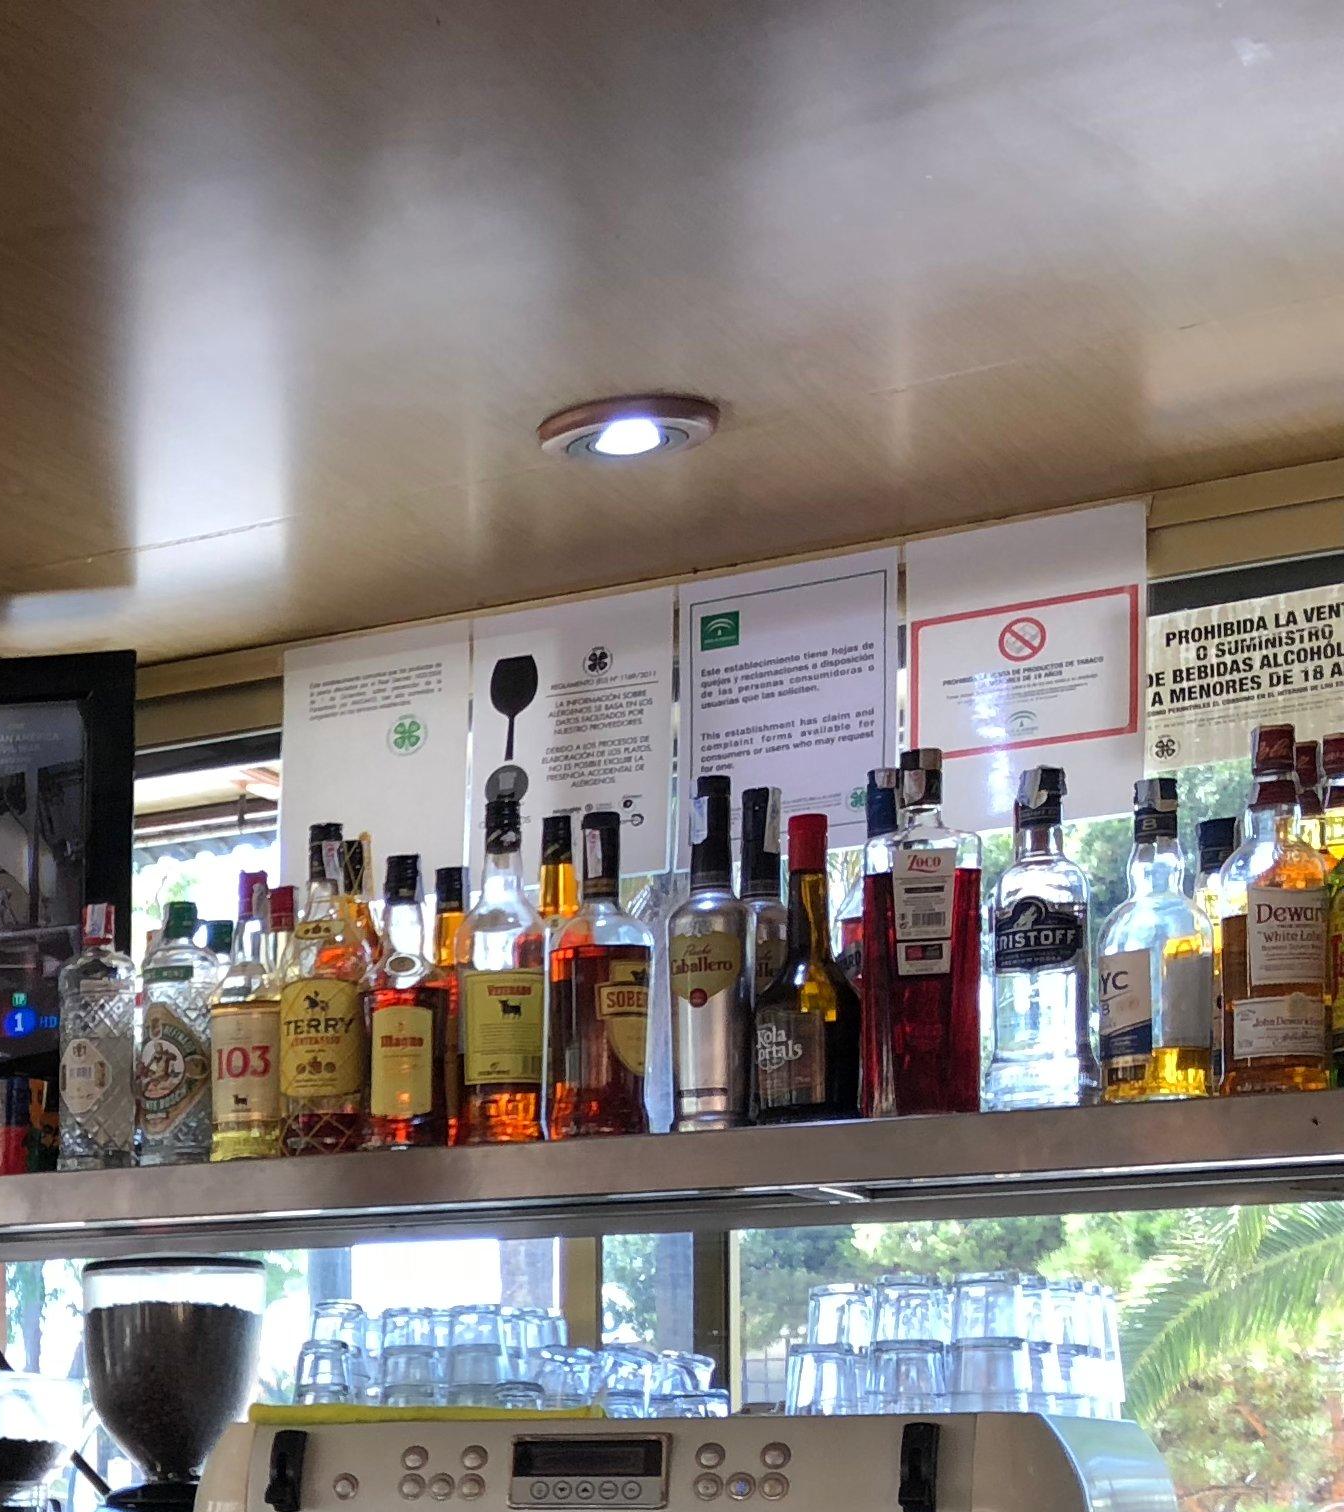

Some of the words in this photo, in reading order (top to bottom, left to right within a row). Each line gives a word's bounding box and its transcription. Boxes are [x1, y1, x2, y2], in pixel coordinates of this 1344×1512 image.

[1165, 616, 1268, 647] PROHIBIDA
[1274, 610, 1298, 628] LA
[1303, 602, 1344, 622] VEN
[1196, 645, 1208, 661] O
[1215, 624, 1333, 658] SUMINISTRO
[701, 668, 721, 678] Este
[724, 653, 801, 674] establecimiento
[803, 649, 828, 660] tiene
[831, 644, 859, 656] hojas
[862, 641, 875, 651] de
[741, 663, 810, 682] reclamaciones
[1172, 657, 1254, 684] BEBIDAS
[1259, 640, 1344, 670] ALCOHÓL
[701, 690, 713, 699] de
[718, 687, 733, 696] las
[738, 679, 784, 694] personas
[1151, 691, 1164, 707] A
[1170, 674, 1262, 704] MENORES
[1268, 669, 1293, 688] DE
[1300, 665, 1324, 682] 18
[1330, 661, 1344, 679] A
[742, 693, 760, 704] que
[701, 731, 721, 742] This
[724, 720, 795, 737] establishment
[799, 717, 818, 727] has
[822, 712, 851, 723] claim
[855, 708, 875, 718] and
[701, 738, 754, 754] complaint
[761, 732, 793, 743] forms
[800, 722, 851, 738] available
[858, 719, 875, 728] for
[700, 750, 751, 763] consumers
[753, 747, 763, 755] or
[765, 743, 790, 754] users
[792, 738, 813, 748] who
[814, 735, 835, 747] may
[700, 764, 713, 773] for
[1256, 903, 1323, 924] Dewar
[1100, 971, 1129, 995] YC
[606, 990, 648, 1009] SOBE
[283, 1017, 355, 1037] TERRY
[216, 1044, 272, 1081] 103
[758, 1039, 803, 1061] ortals
